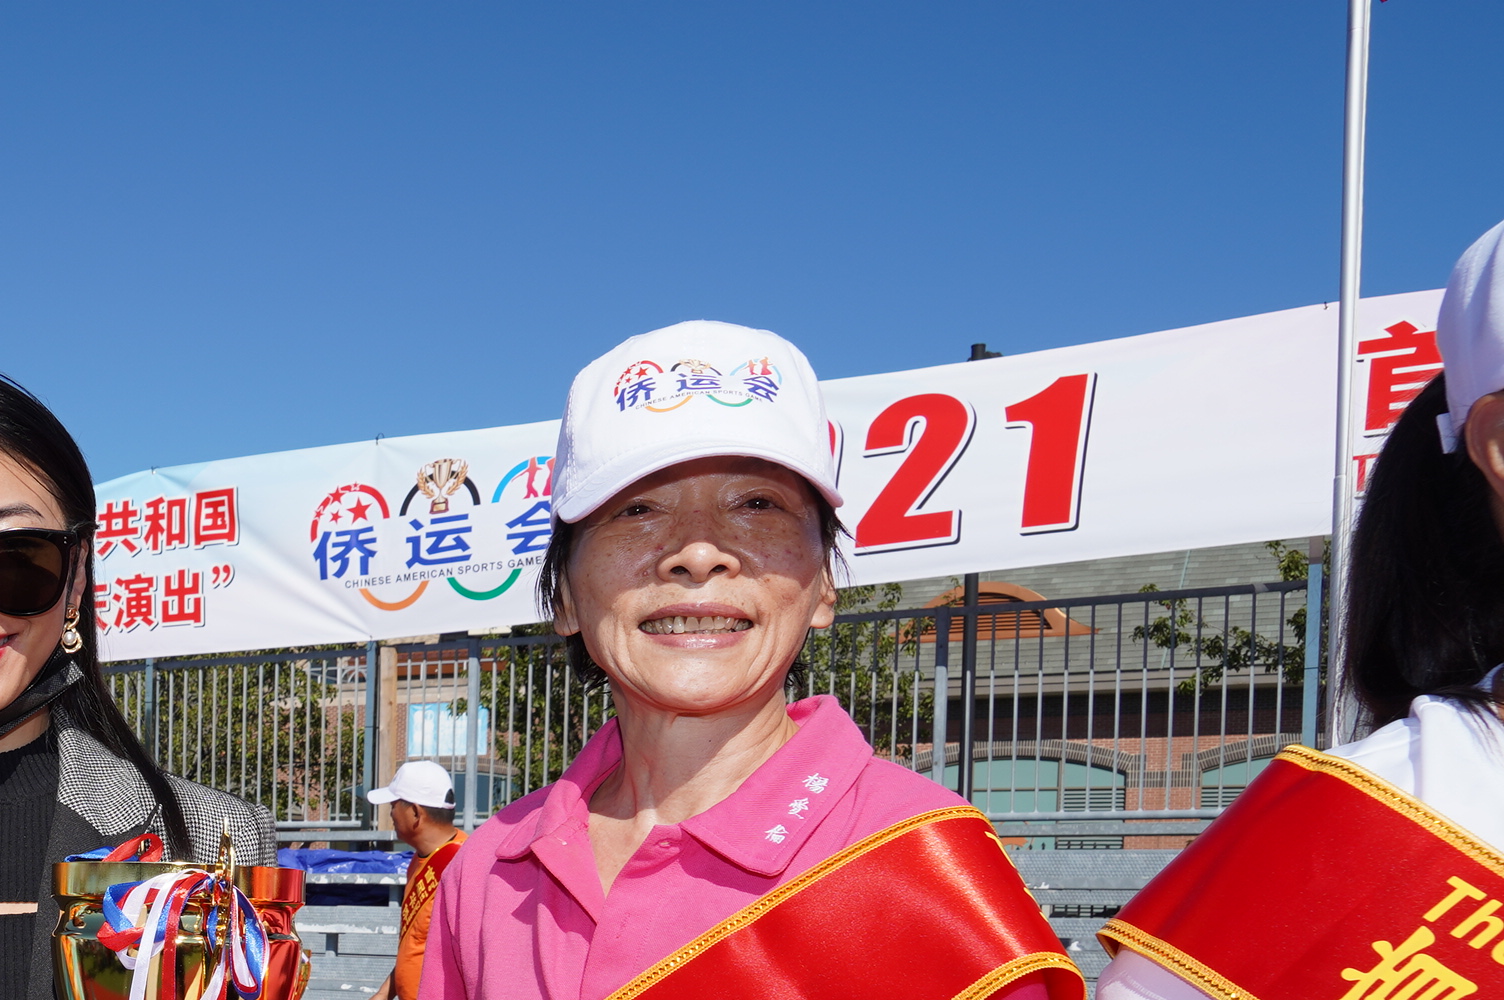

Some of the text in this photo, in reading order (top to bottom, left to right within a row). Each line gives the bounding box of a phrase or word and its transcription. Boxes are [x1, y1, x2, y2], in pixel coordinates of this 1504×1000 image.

[616, 375, 780, 412] 侨运会
[635, 396, 667, 410] CHINESE
[669, 390, 710, 401] AMERICAN
[829, 372, 1098, 556] 21
[95, 487, 237, 558] 共和国
[313, 500, 553, 581] 侨运会
[345, 555, 543, 589] CHINESE AMERICAN SPORTS GAME
